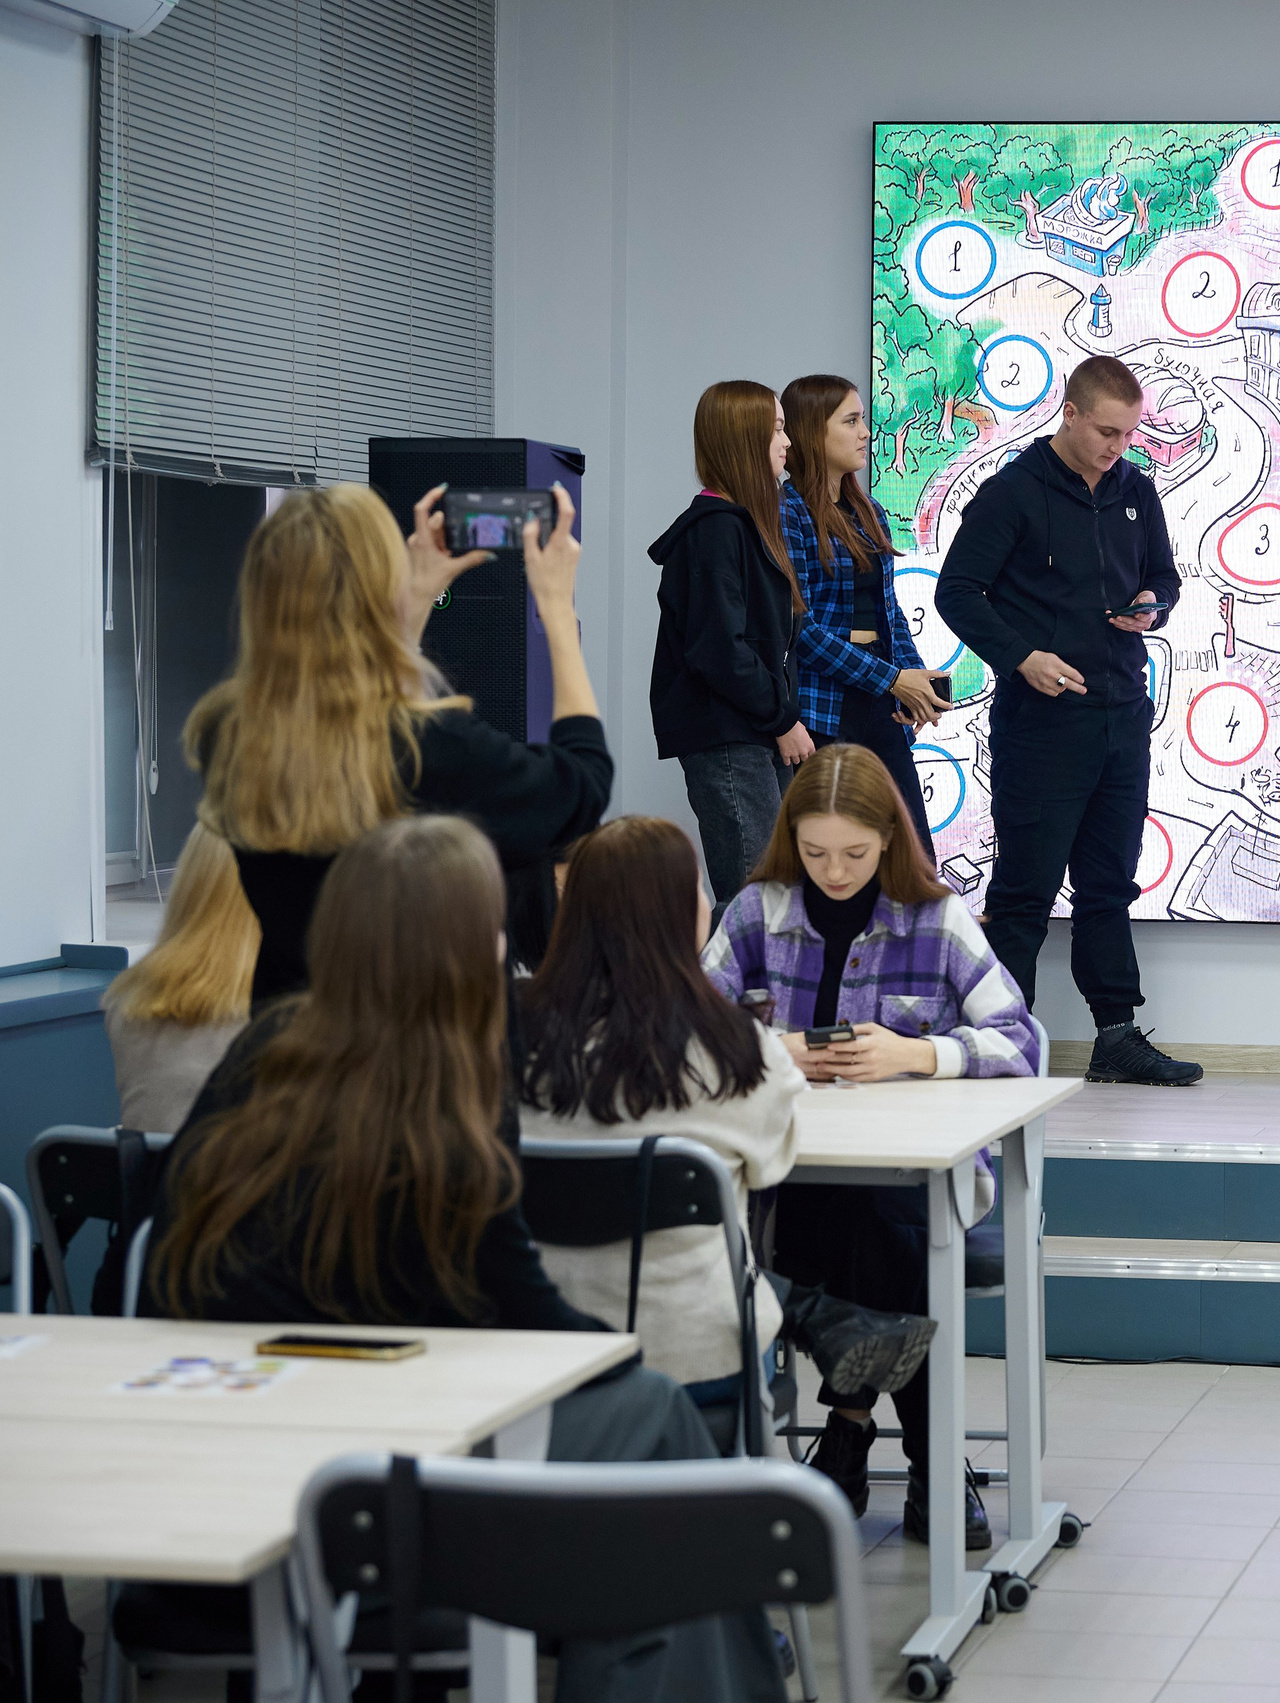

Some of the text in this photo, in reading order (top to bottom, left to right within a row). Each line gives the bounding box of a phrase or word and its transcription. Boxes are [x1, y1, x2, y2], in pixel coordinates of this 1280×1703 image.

[950, 241, 962, 273] 1
[1192, 271, 1216, 299] 2
[1000, 362, 1020, 388] 2
[1254, 523, 1270, 556] 3
[912, 606, 925, 637] 3
[1225, 705, 1241, 744] 4
[922, 772, 934, 803] 5
